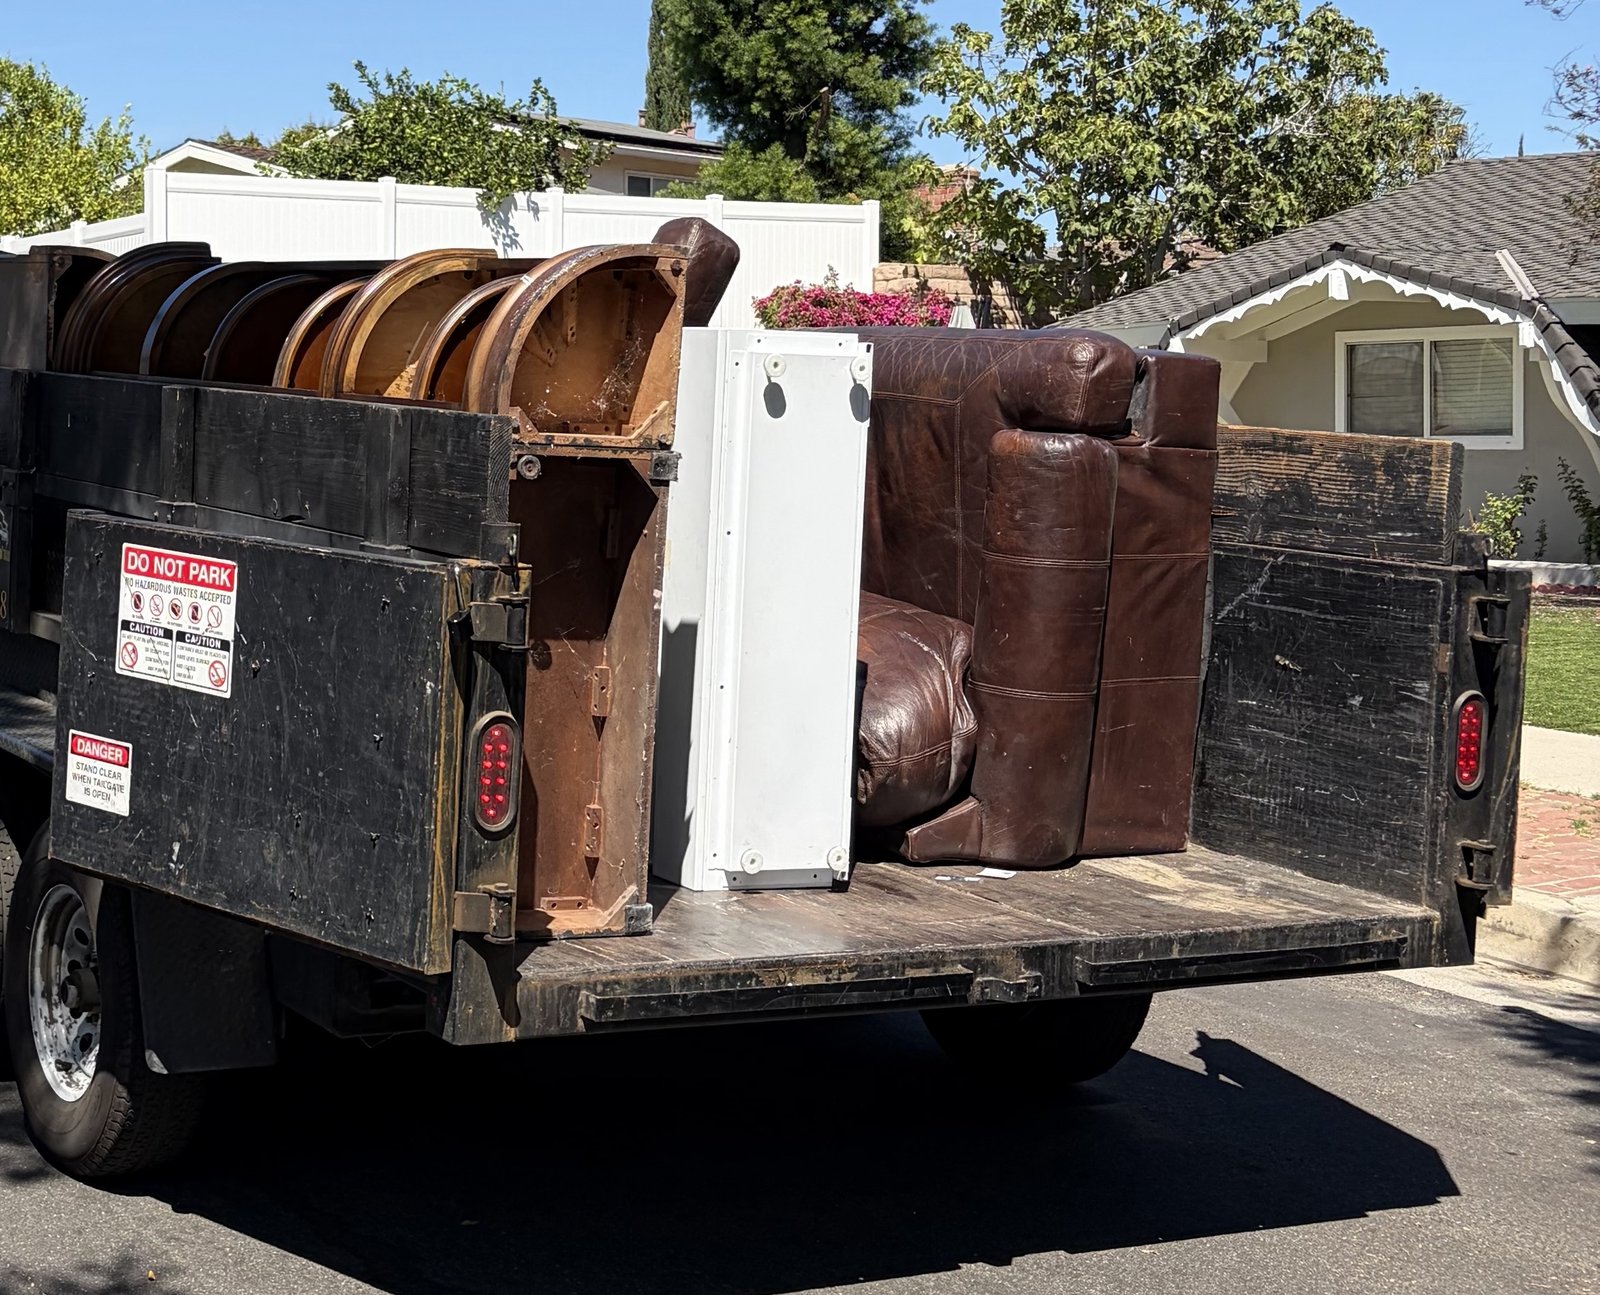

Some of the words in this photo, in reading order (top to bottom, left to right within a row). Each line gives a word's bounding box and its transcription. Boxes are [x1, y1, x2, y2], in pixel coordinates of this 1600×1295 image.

[127, 552, 149, 572] DO
[154, 557, 186, 579] NOT
[189, 562, 232, 587] PARK
[125, 577, 133, 587] NO
[135, 579, 172, 594] HAZARDOUS
[173, 585, 198, 599] WASTES
[199, 592, 232, 605] ACCEPTED
[129, 622, 164, 637] CAUTION
[185, 634, 221, 649] CAUTION
[76, 738, 123, 763] DANGER
[72, 773, 92, 785] WHEN
[76, 761, 98, 775] STAND
[99, 767, 122, 780] CLEAR
[84, 787, 91, 796] IS
[92, 789, 111, 801] OPEN
